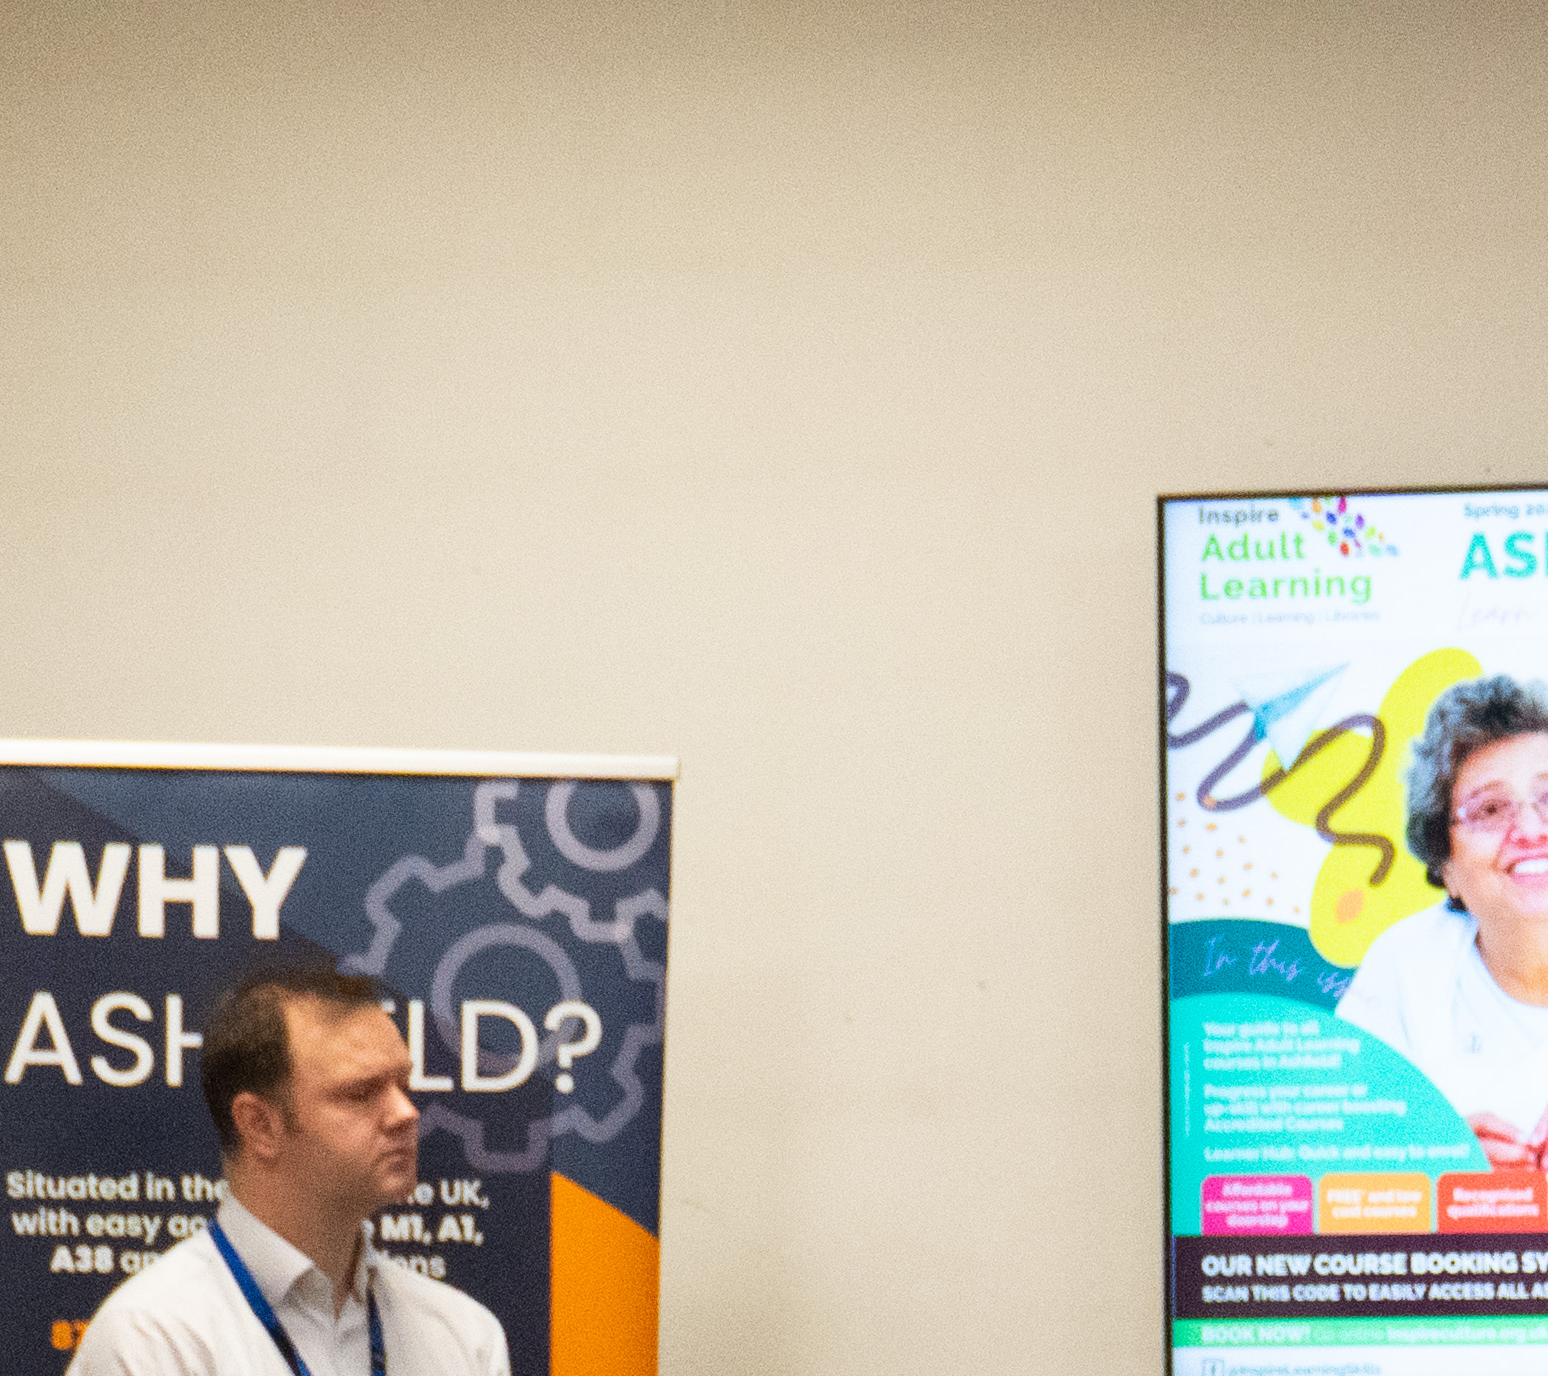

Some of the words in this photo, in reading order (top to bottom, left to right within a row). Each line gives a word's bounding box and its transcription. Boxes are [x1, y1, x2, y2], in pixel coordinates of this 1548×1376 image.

[1198, 504, 1281, 526] Inspire
[1200, 531, 1306, 562] Adult
[1200, 572, 1373, 604] Learning
[3, 840, 308, 939] WHY
[6, 1170, 139, 1201] Situated
[145, 1171, 176, 1201] in
[440, 1180, 490, 1209] UK,
[11, 1207, 81, 1236] with
[86, 1212, 161, 1244] easy
[381, 1215, 432, 1244] M1,
[437, 1214, 485, 1246] A1,
[50, 1245, 114, 1274] A38
[1201, 1254, 1253, 1278] OUR
[1255, 1254, 1312, 1277] NEW
[1313, 1252, 1407, 1276] COURSE
[1410, 1251, 1518, 1275] BOOKING
[1201, 1285, 1250, 1303] SCAN
[1251, 1285, 1291, 1302] THIS
[1292, 1284, 1340, 1302] CODE
[1341, 1284, 1367, 1301] TO
[1368, 1283, 1427, 1301] EASILY
[1428, 1282, 1494, 1300] ACCESS
[1496, 1282, 1530, 1299] ALL
